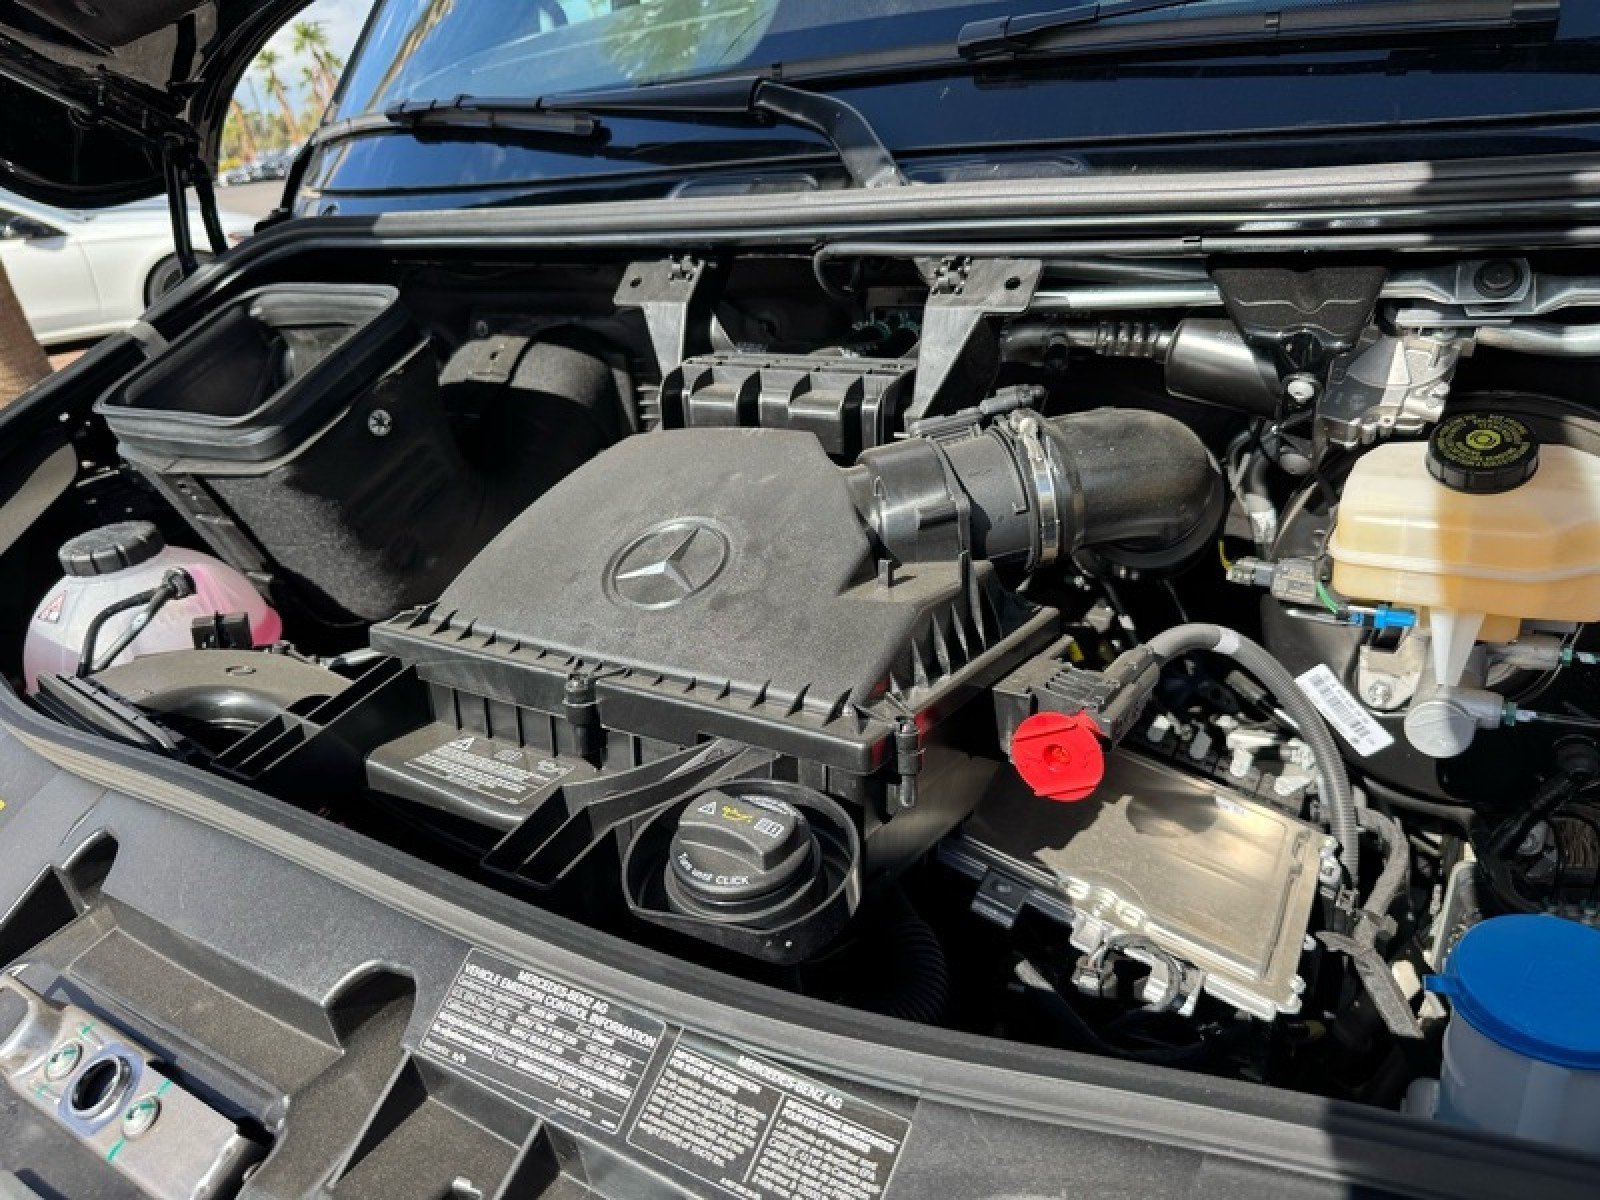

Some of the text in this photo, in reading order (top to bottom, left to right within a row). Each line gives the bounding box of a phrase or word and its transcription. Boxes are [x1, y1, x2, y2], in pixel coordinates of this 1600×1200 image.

[715, 875, 749, 885] CLICK
[462, 962, 502, 986] VEHICLE
[498, 976, 546, 1003] EMISSION
[542, 994, 590, 1021] CONTROL
[587, 1011, 657, 1048] INFORMATION
[515, 969, 610, 1015] MERCEDES-BENZ AG
[734, 1053, 845, 1111] MERCEDES-BENZ AG
